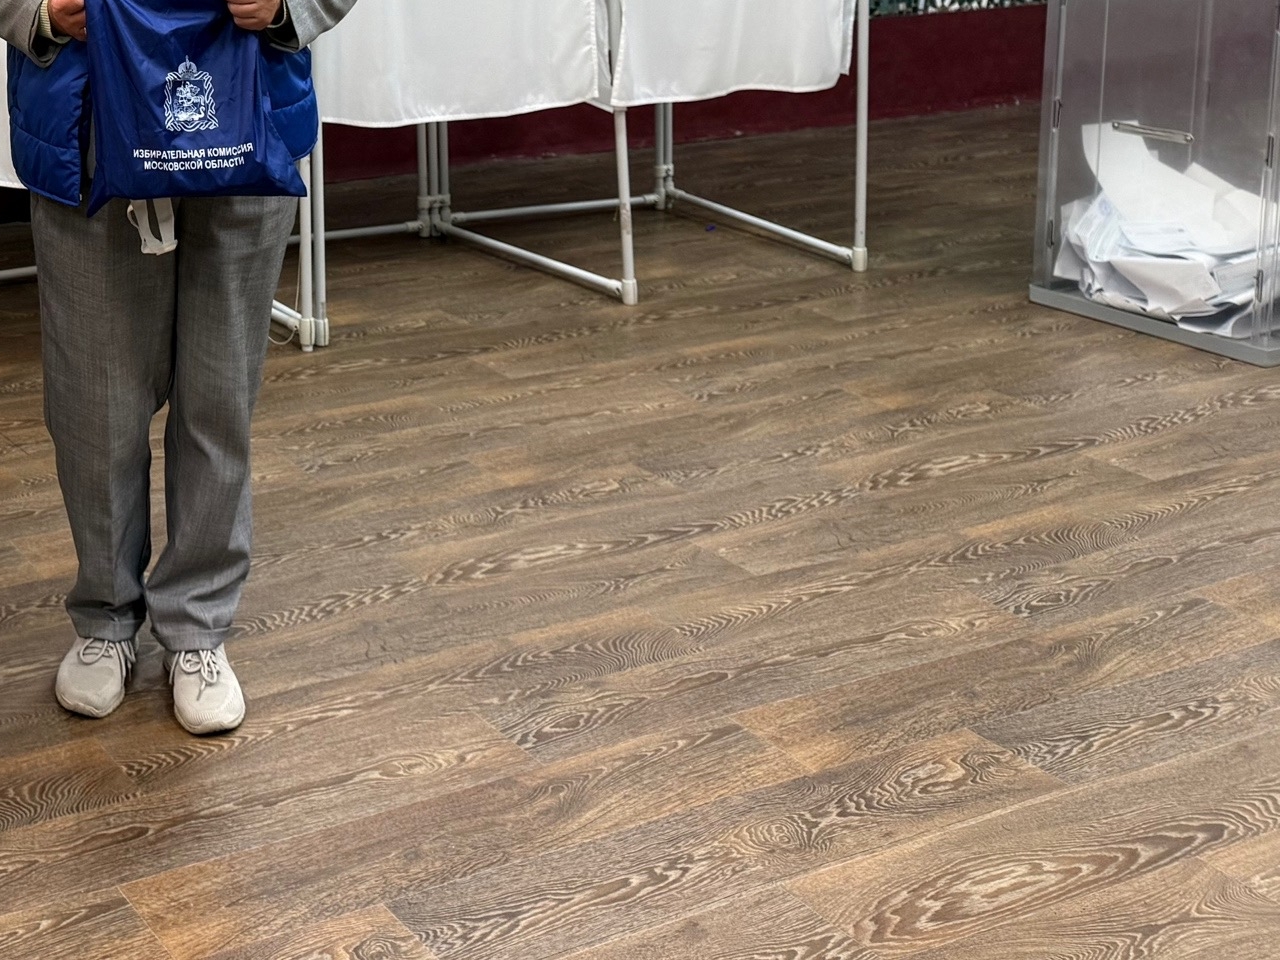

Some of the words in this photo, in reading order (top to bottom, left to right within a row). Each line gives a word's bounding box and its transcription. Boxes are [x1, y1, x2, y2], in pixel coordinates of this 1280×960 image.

[133, 148, 206, 160] ИЗБИРАТЕЛЬНАЯ
[207, 142, 254, 158] КОМИССИЯ
[144, 159, 203, 171] МОСКОВСКОЙ
[204, 156, 245, 170] ОБЛАСТИ
